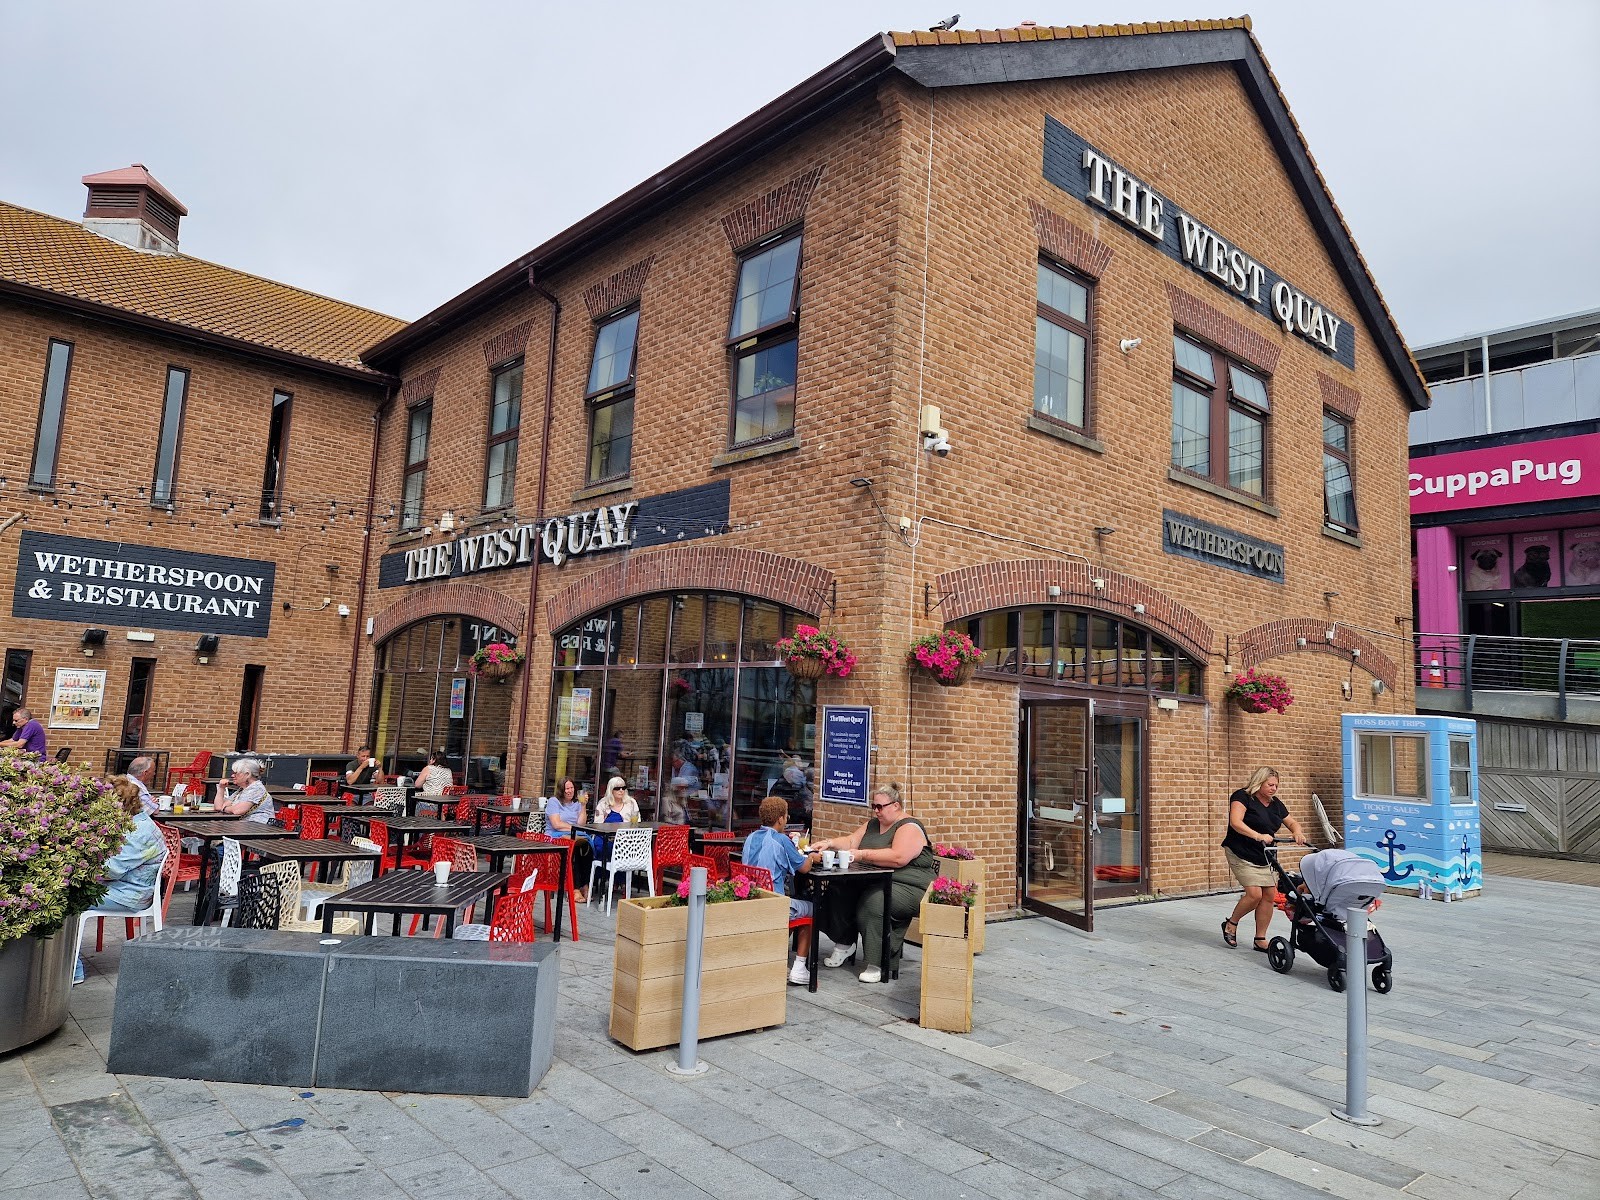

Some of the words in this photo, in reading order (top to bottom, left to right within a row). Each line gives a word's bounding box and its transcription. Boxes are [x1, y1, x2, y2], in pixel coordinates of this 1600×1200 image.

[1082, 149, 1165, 243] THE
[1176, 212, 1265, 305] WEST
[1271, 281, 1341, 353] QUAY
[1408, 459, 1582, 498] CuppaPug
[404, 542, 453, 582] THE
[459, 524, 536, 573] WEST
[543, 501, 639, 566] QUAY
[1166, 520, 1284, 573] WETHERSPOON
[1523, 535, 1549, 543] DEREK
[34, 551, 265, 595] WETHERSPOON
[28, 579, 53, 600] &
[60, 581, 260, 619] RESTAURANT
[851, 716, 863, 724] Quay
[1354, 718, 1376, 726] ROSS
[1378, 719, 1399, 727] BOAT
[1363, 803, 1392, 812] TICKET
[1393, 806, 1421, 815] SALES
